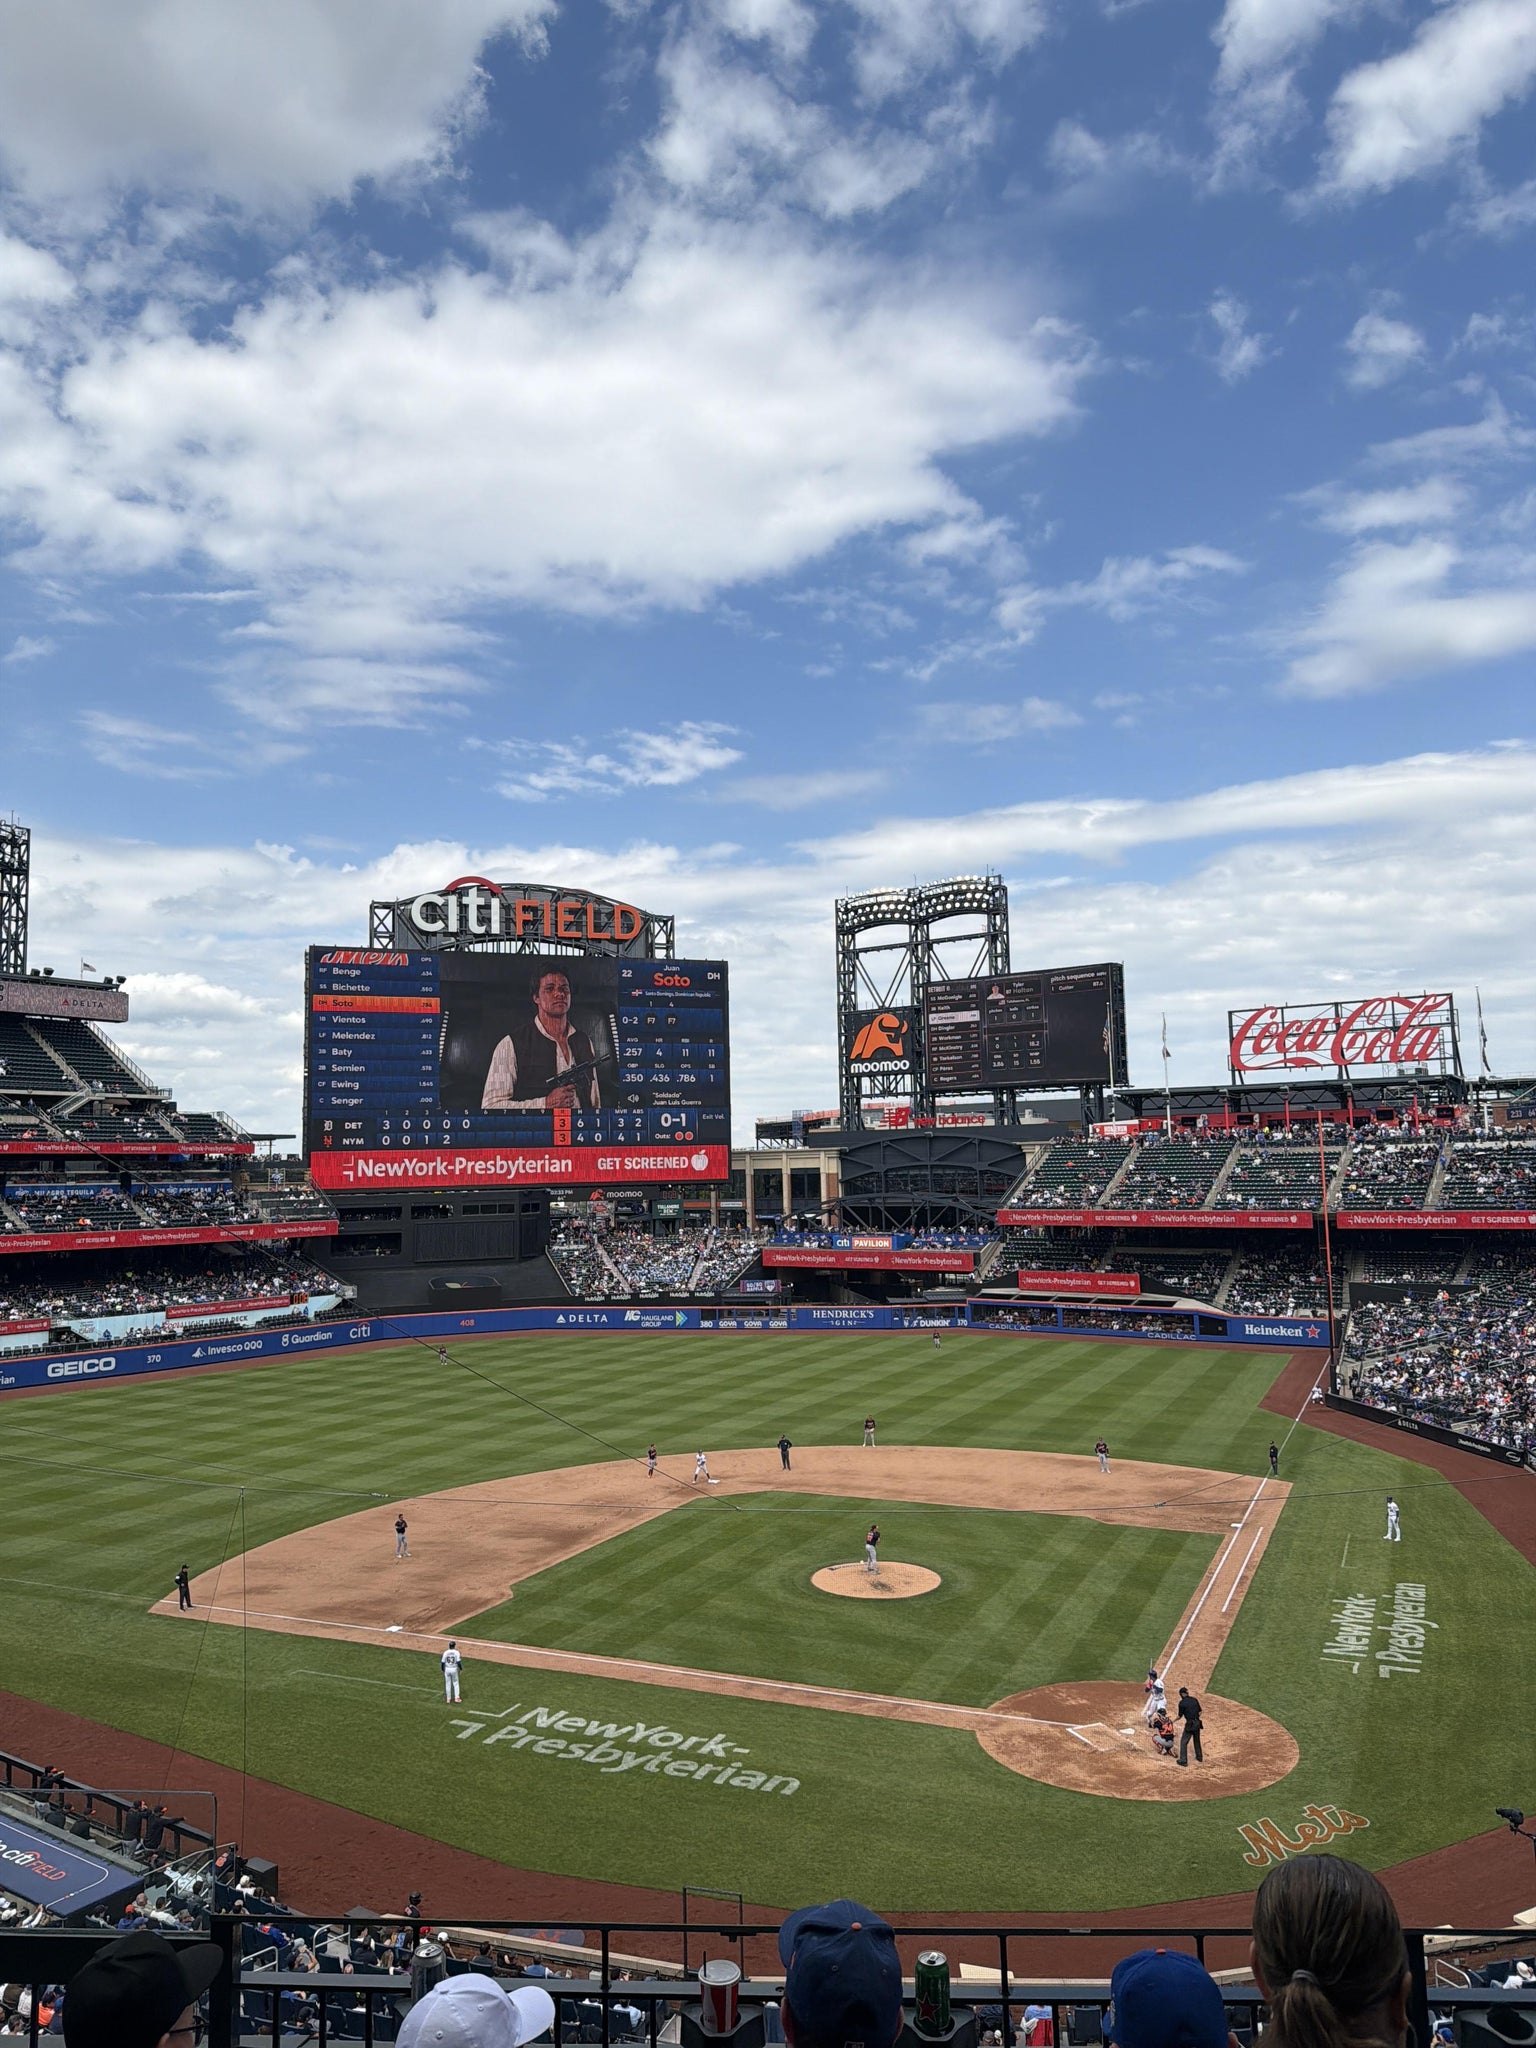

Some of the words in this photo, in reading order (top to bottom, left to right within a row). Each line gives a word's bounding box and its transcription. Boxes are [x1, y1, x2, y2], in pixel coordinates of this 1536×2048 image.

[411, 885, 500, 934] citi
[515, 899, 642, 940] FIELD
[332, 967, 361, 977] Benge
[622, 970, 632, 978] 22
[654, 972, 691, 988] Soto
[1050, 975, 1066, 984] pitch
[1066, 972, 1096, 980] sequence
[332, 983, 370, 992] Bichette
[72, 1000, 104, 1008] DELTA
[332, 1016, 366, 1024] Vientos
[622, 1016, 638, 1024] 0-2
[332, 1032, 376, 1040] Melendez
[1231, 993, 1452, 1070] Coca-Cola
[332, 1048, 352, 1057] Baty
[623, 1048, 642, 1056] .257
[656, 1048, 662, 1056] 4
[682, 1048, 688, 1056] 11
[708, 1048, 714, 1056] 11
[332, 1064, 366, 1072] Semien
[851, 1060, 910, 1074] moomoo
[622, 1074, 644, 1082] .350
[650, 1074, 670, 1082] .436
[676, 1074, 696, 1082] .786
[710, 1074, 714, 1082] 1
[332, 1080, 360, 1090] Ewing
[332, 1097, 364, 1106] Senger
[382, 1120, 390, 1130] 3
[402, 1120, 410, 1129] 0
[422, 1120, 430, 1129] 0
[442, 1119, 450, 1129] 0
[462, 1119, 470, 1128] 0
[560, 1118, 566, 1128] 3
[577, 1118, 584, 1128] 6
[596, 1118, 600, 1127] 1
[618, 1118, 624, 1127] 3
[634, 1118, 642, 1127] 2
[660, 1112, 686, 1127] 0-1
[914, 1117, 936, 1126] new
[938, 1114, 986, 1125] balance
[382, 1136, 390, 1145] 0
[402, 1135, 410, 1145] 0
[424, 1135, 428, 1144] 1
[443, 1135, 450, 1144] 2
[560, 1134, 566, 1142] 3
[576, 1133, 584, 1142] 4
[594, 1133, 602, 1142] 0
[618, 1132, 624, 1142] 4
[636, 1132, 640, 1142] 1
[357, 1154, 572, 1180] NewYork-Presbyterian
[597, 1156, 622, 1170] GET
[624, 1155, 688, 1170] SCREENED
[1012, 1214, 1084, 1222] NewYork-Presbyterian
[1154, 1214, 1236, 1224] NewYork-Presbyterian
[1353, 1215, 1456, 1226] NewYork-Presbyterian
[776, 1254, 836, 1263] NewYork-Presbyterian
[894, 1256, 962, 1266] NewYork-Presbyterian
[568, 1314, 608, 1322] DELTA
[812, 1310, 874, 1318] HENDRICK'S
[1147, 1332, 1197, 1340] CADILLAC
[1244, 1324, 1302, 1337] Heineken
[291, 1332, 332, 1344] Guardian
[208, 1344, 242, 1356] Invesco
[244, 1340, 263, 1350] QQQ
[147, 1354, 162, 1364] 370
[48, 1357, 116, 1378] GEICO
[1402, 1420, 1419, 1430] DELTA
[1322, 1593, 1376, 1658] NewYork-
[1375, 1582, 1440, 1664] Presbyterian
[516, 1706, 750, 1758] NewYork-
[482, 1726, 800, 1796] Presbyterian
[1238, 1803, 1370, 1867] Mets
[25, 1860, 66, 1880] FIELD
